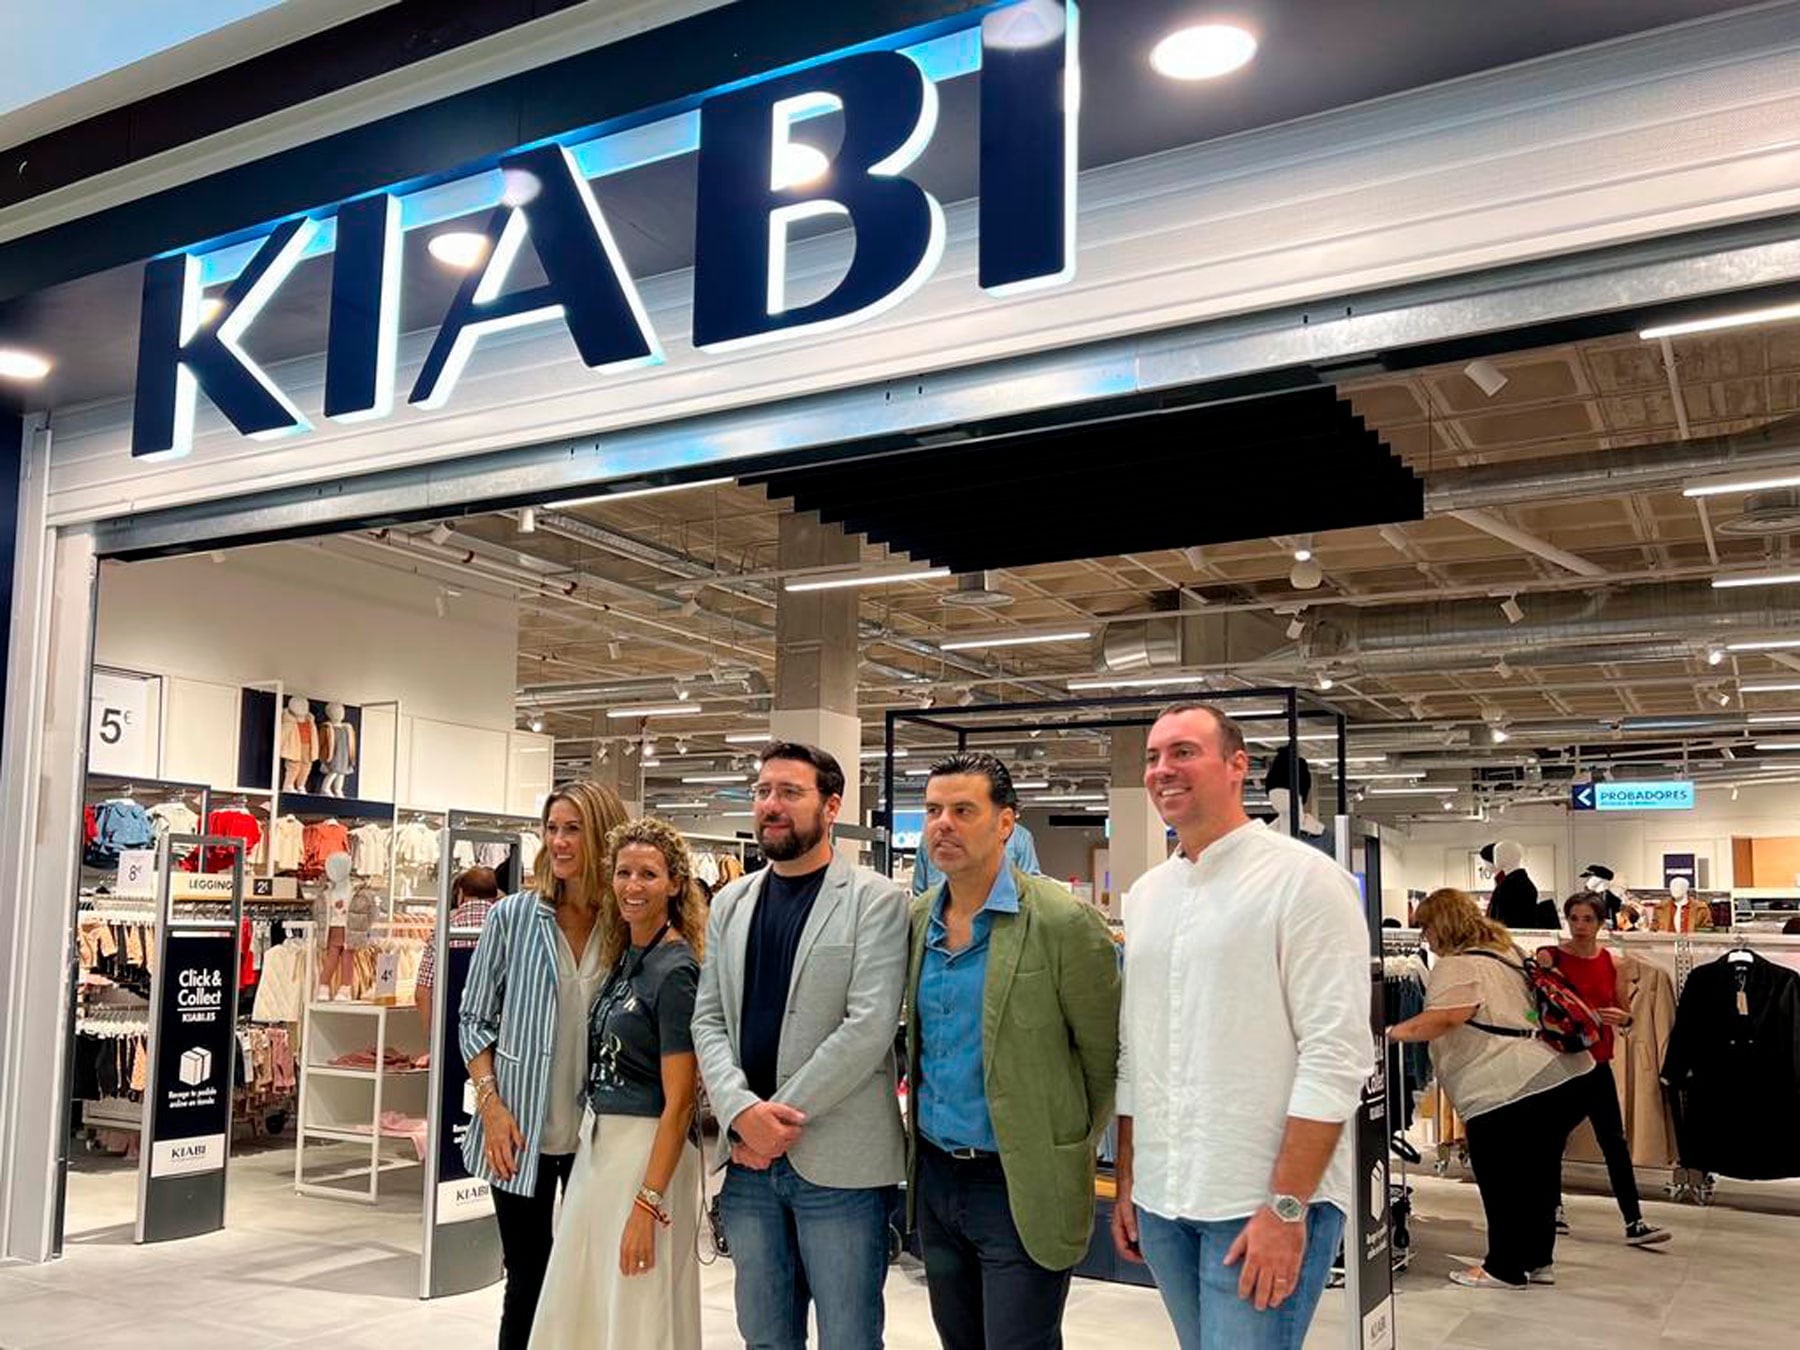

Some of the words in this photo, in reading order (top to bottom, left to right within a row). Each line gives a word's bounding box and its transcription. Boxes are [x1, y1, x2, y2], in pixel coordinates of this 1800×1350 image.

[132, 0, 1079, 462] KIABI
[1600, 790, 1688, 801] PROBADORES
[178, 968, 211, 988] Click
[177, 987, 222, 1006] Collect
[171, 1145, 206, 1158] KIABI
